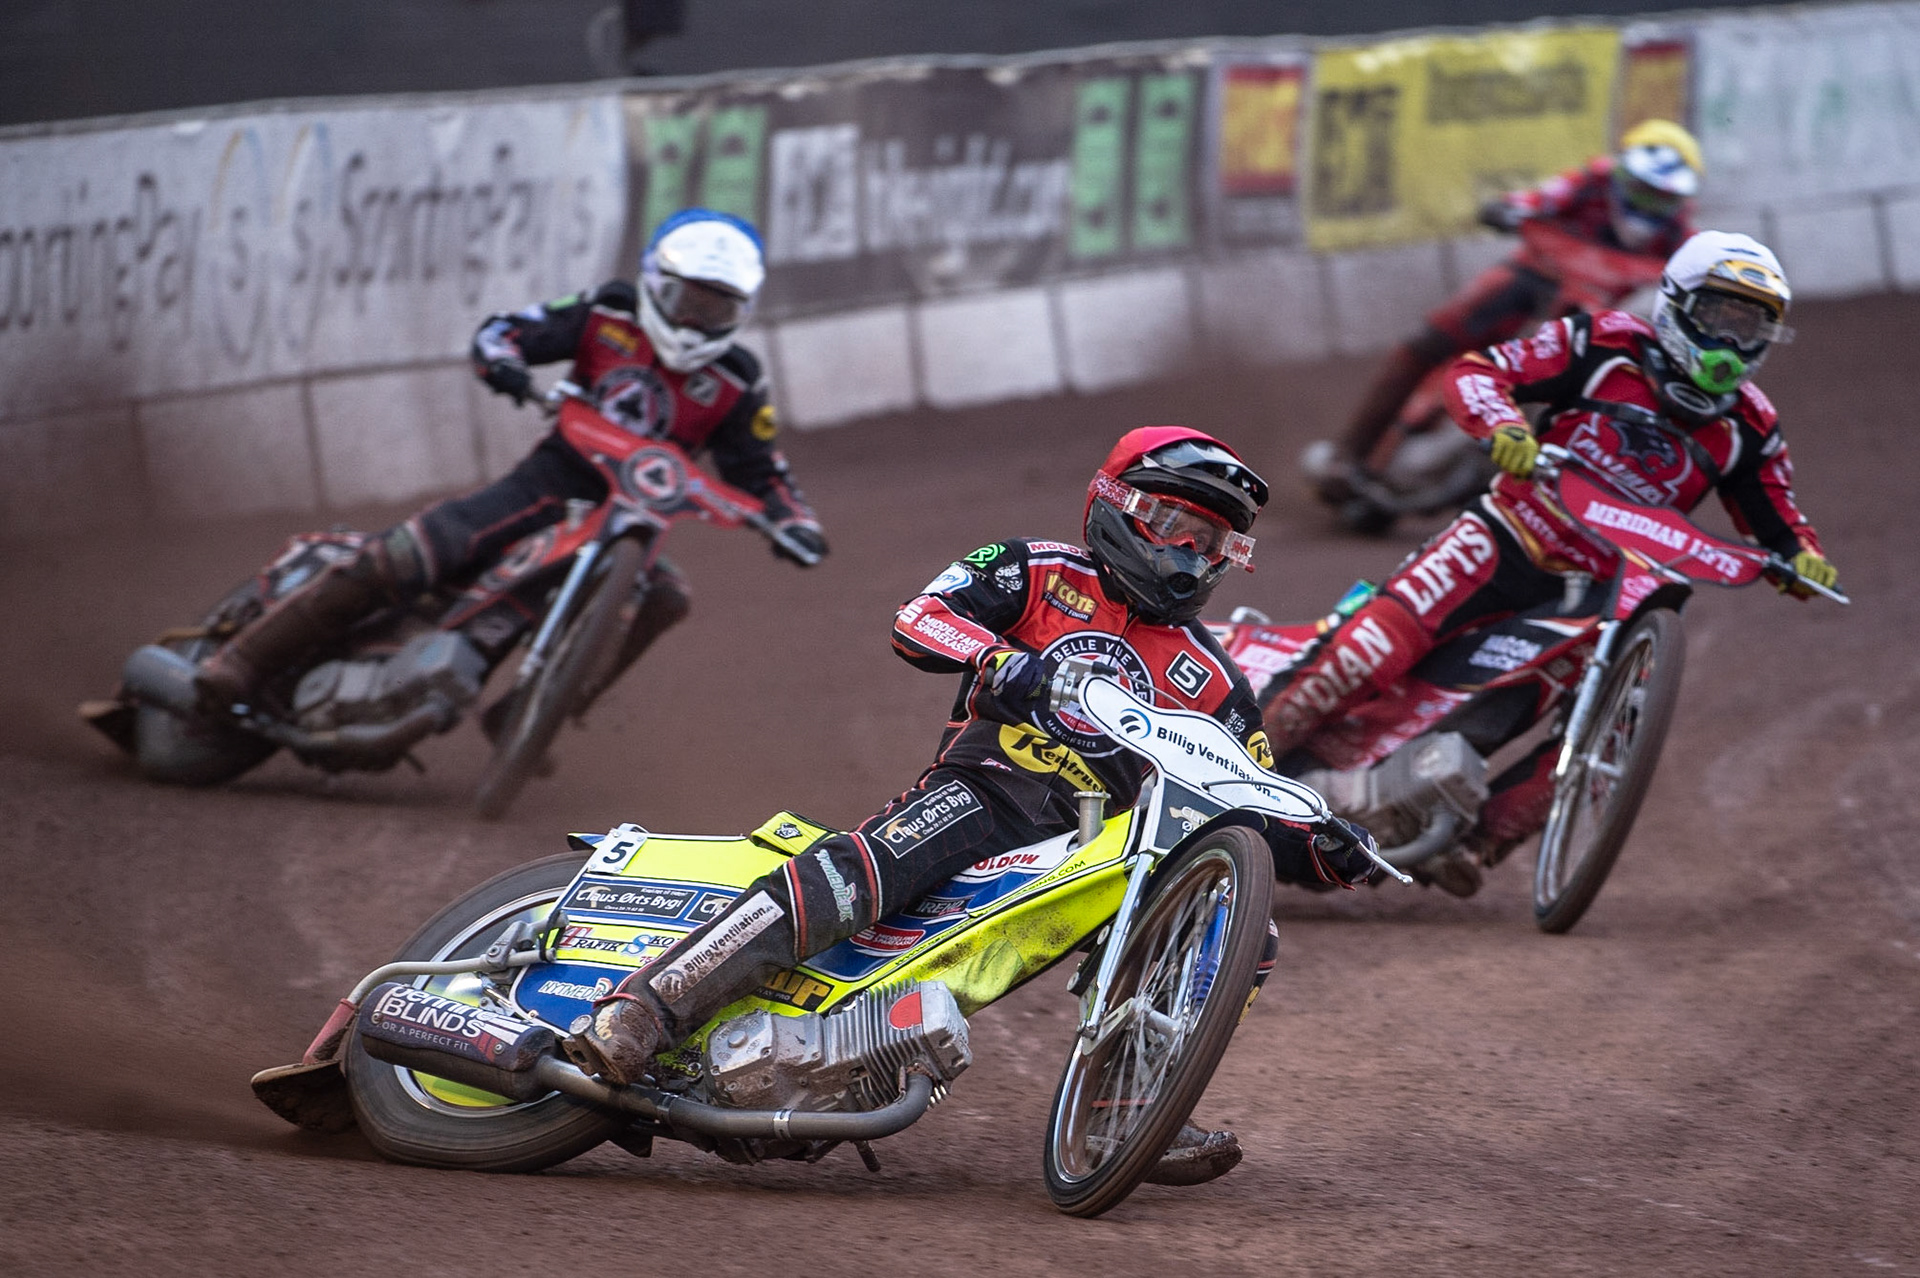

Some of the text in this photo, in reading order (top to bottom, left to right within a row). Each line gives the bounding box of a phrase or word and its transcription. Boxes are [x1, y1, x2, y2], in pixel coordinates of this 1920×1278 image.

[1583, 500, 1690, 550] MERIDIAN
[1394, 522, 1494, 617] LIFTS
[913, 620, 976, 655] SPAREKASSE
[920, 613, 985, 650] MIDDELFART
[1051, 639, 1148, 701] BELLE VUE ACE
[1173, 658, 1203, 690] 5
[1156, 726, 1196, 756] Billig
[889, 817, 925, 843] Claus
[922, 801, 951, 824] Ørts
[602, 841, 634, 864] 5
[973, 853, 1041, 871] OLDOW
[575, 889, 618, 903] Claus
[616, 891, 652, 905] Ørts
[683, 948, 714, 974] Billig
[382, 997, 484, 1038] BLINDS
[399, 1026, 407, 1036] A
[408, 1029, 451, 1047] PERFECT
[453, 1040, 470, 1052] FIT
